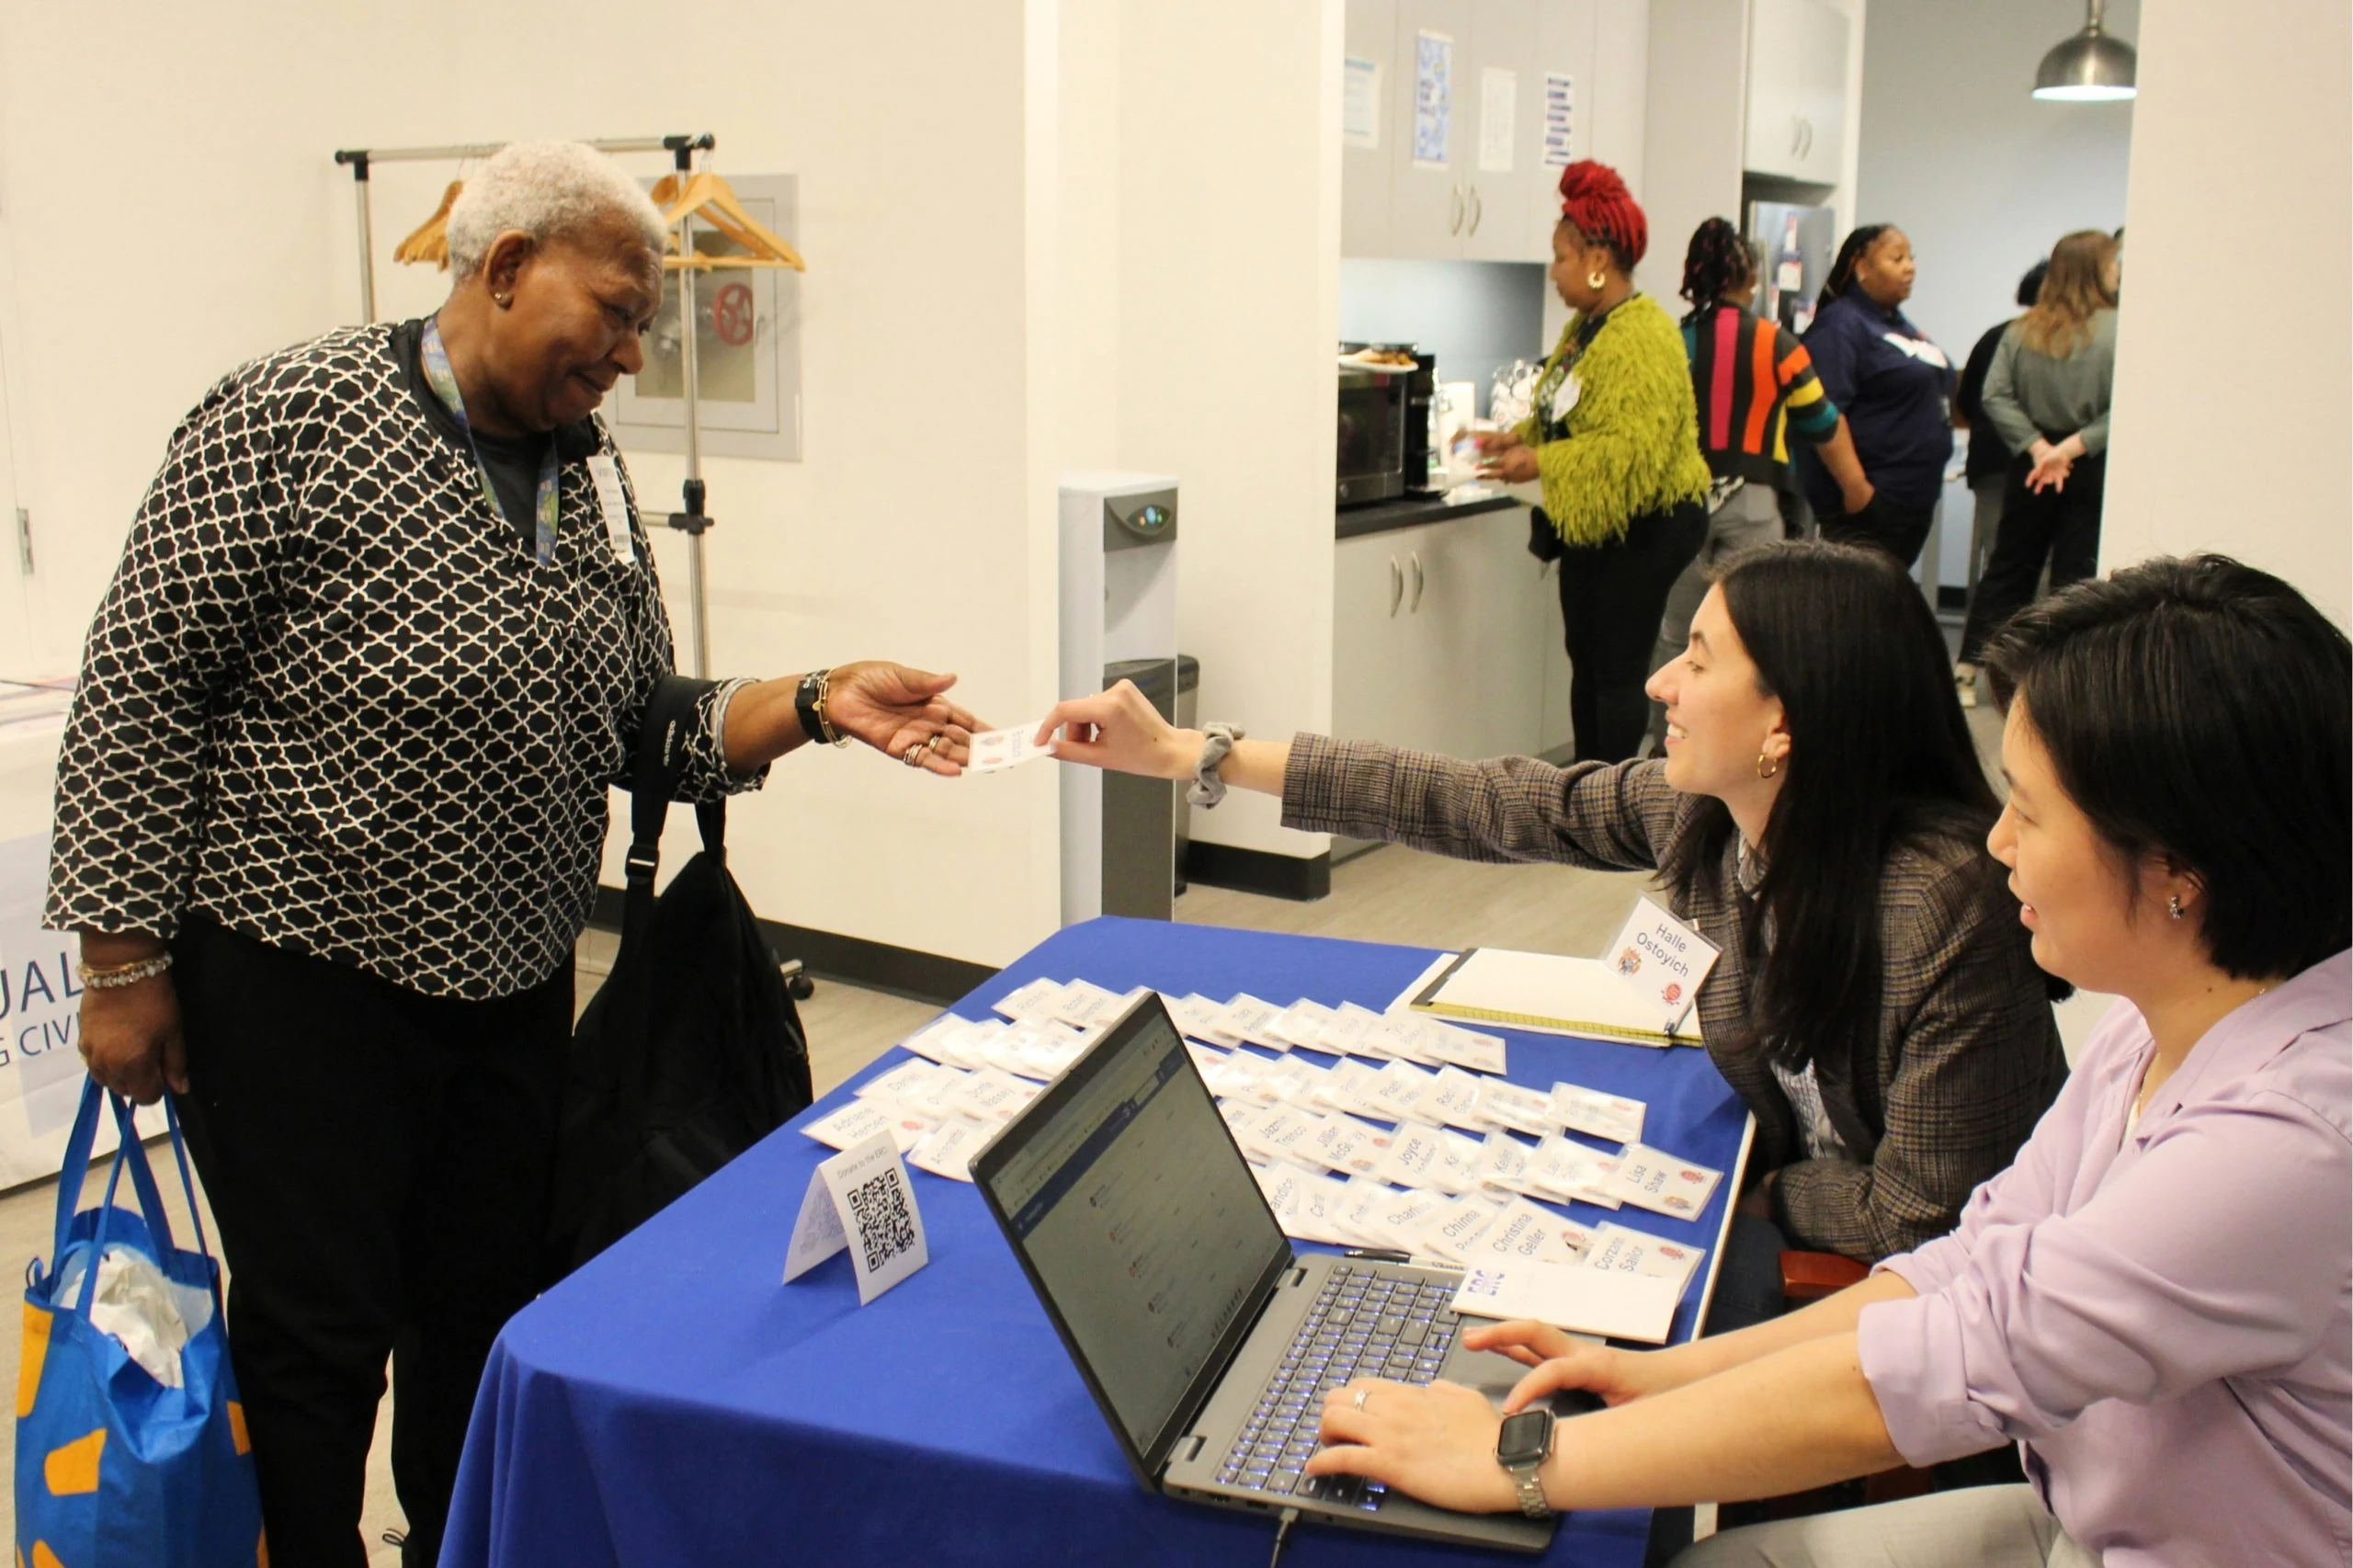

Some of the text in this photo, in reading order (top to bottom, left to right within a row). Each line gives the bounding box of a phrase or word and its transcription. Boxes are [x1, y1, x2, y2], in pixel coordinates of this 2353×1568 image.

[1656, 924, 1688, 953] Halle
[1636, 932, 1689, 977] Ostoyich
[1397, 1138, 1422, 1166] Joyce
[1626, 1165, 1647, 1185] Lisa
[1644, 1169, 1667, 1193] Shaw
[1270, 1177, 1295, 1213] andice
[1493, 1212, 1533, 1253] Christina
[1518, 1228, 1547, 1256] Geller
